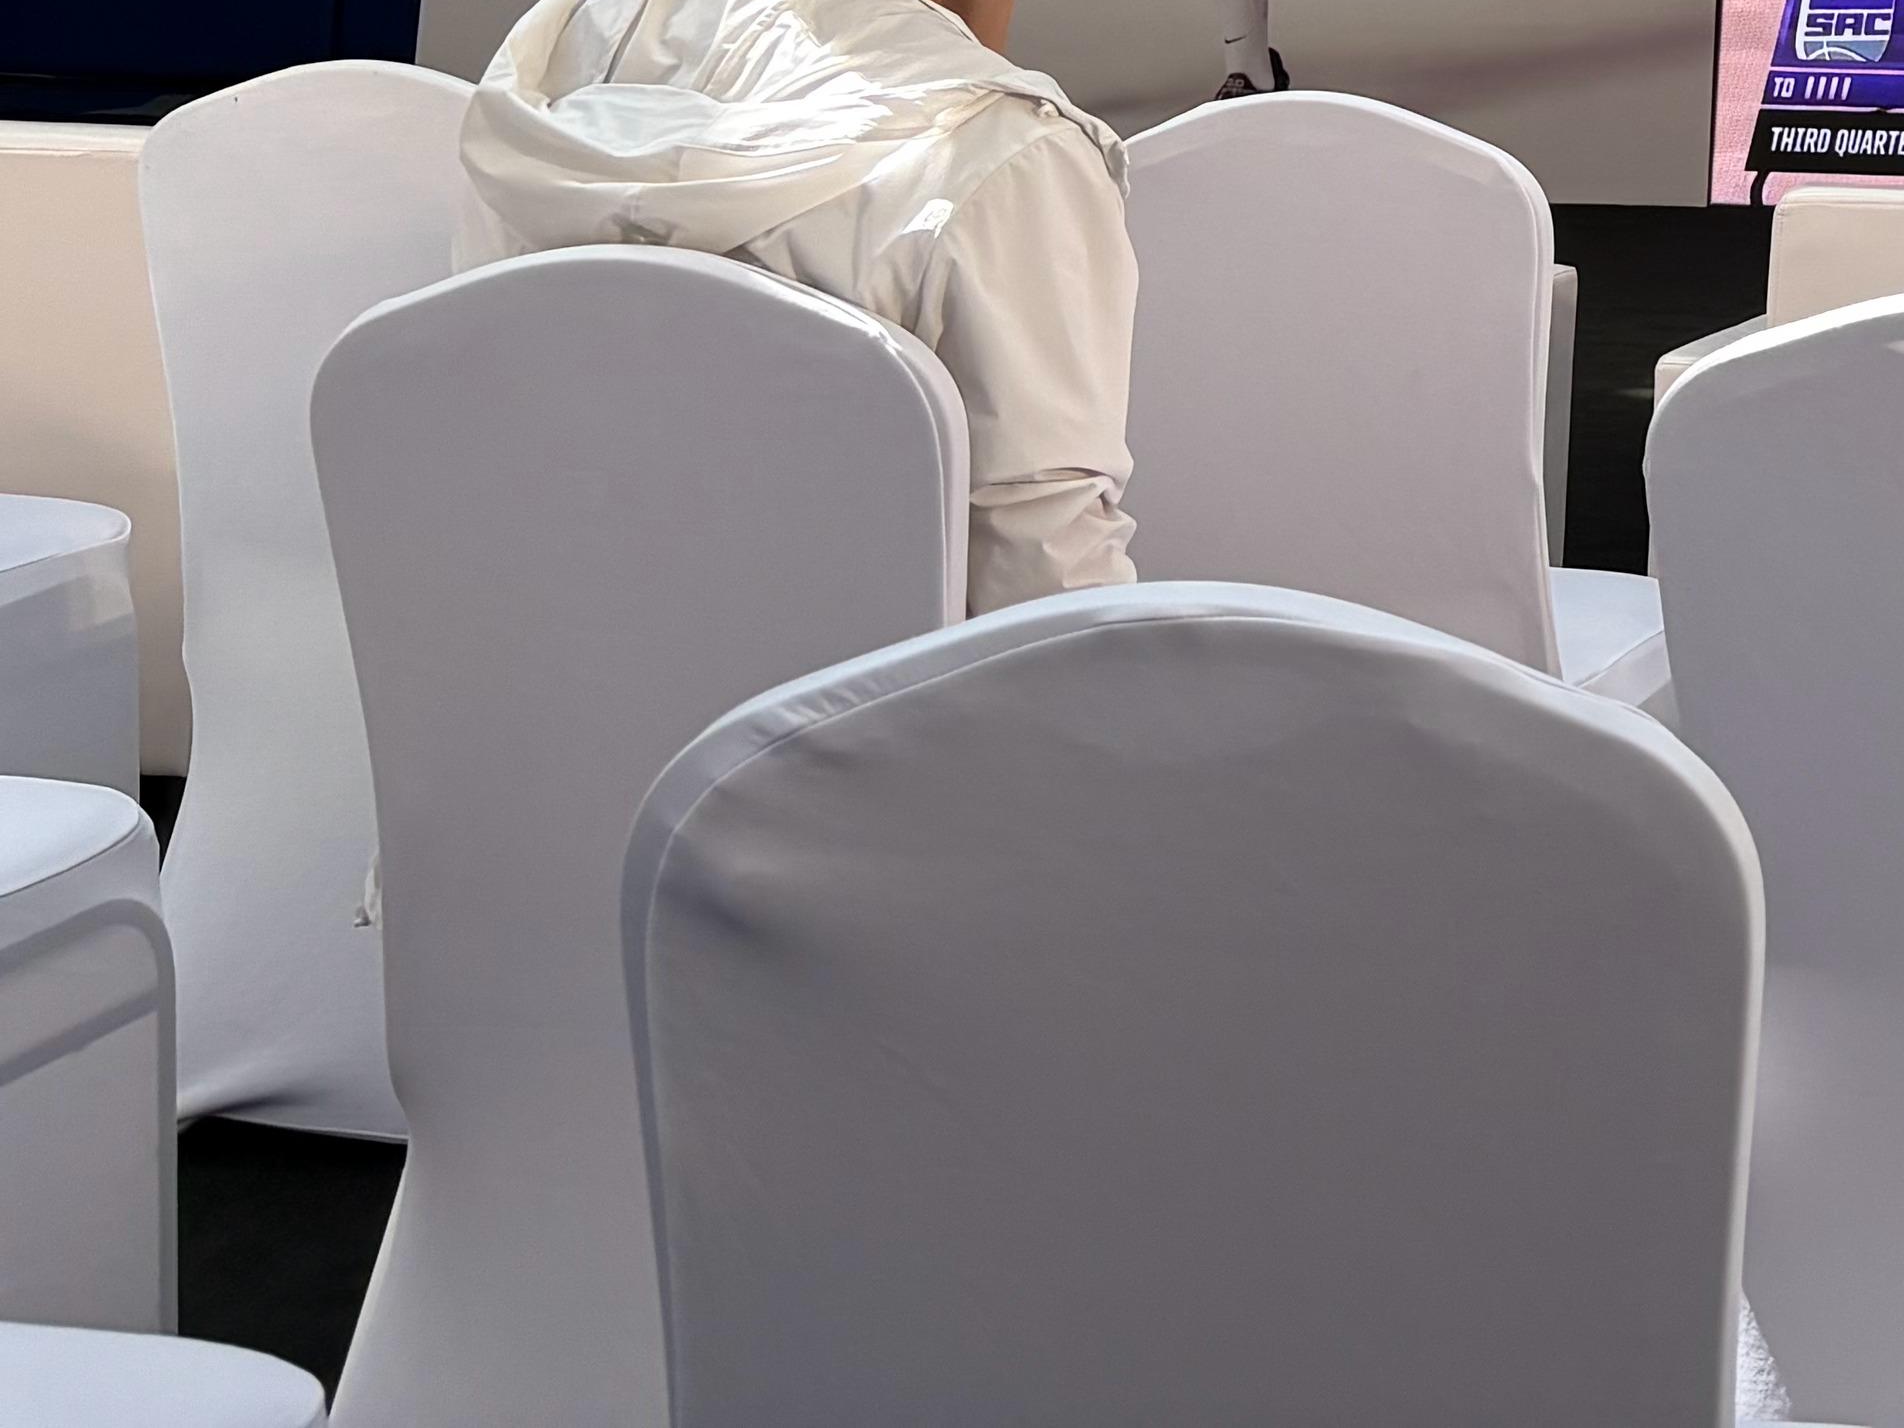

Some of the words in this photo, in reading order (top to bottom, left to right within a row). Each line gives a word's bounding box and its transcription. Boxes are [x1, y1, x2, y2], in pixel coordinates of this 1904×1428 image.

[1803, 12, 1893, 38] SAC
[1773, 76, 1796, 99] TO
[1770, 126, 1830, 154] THIRD
